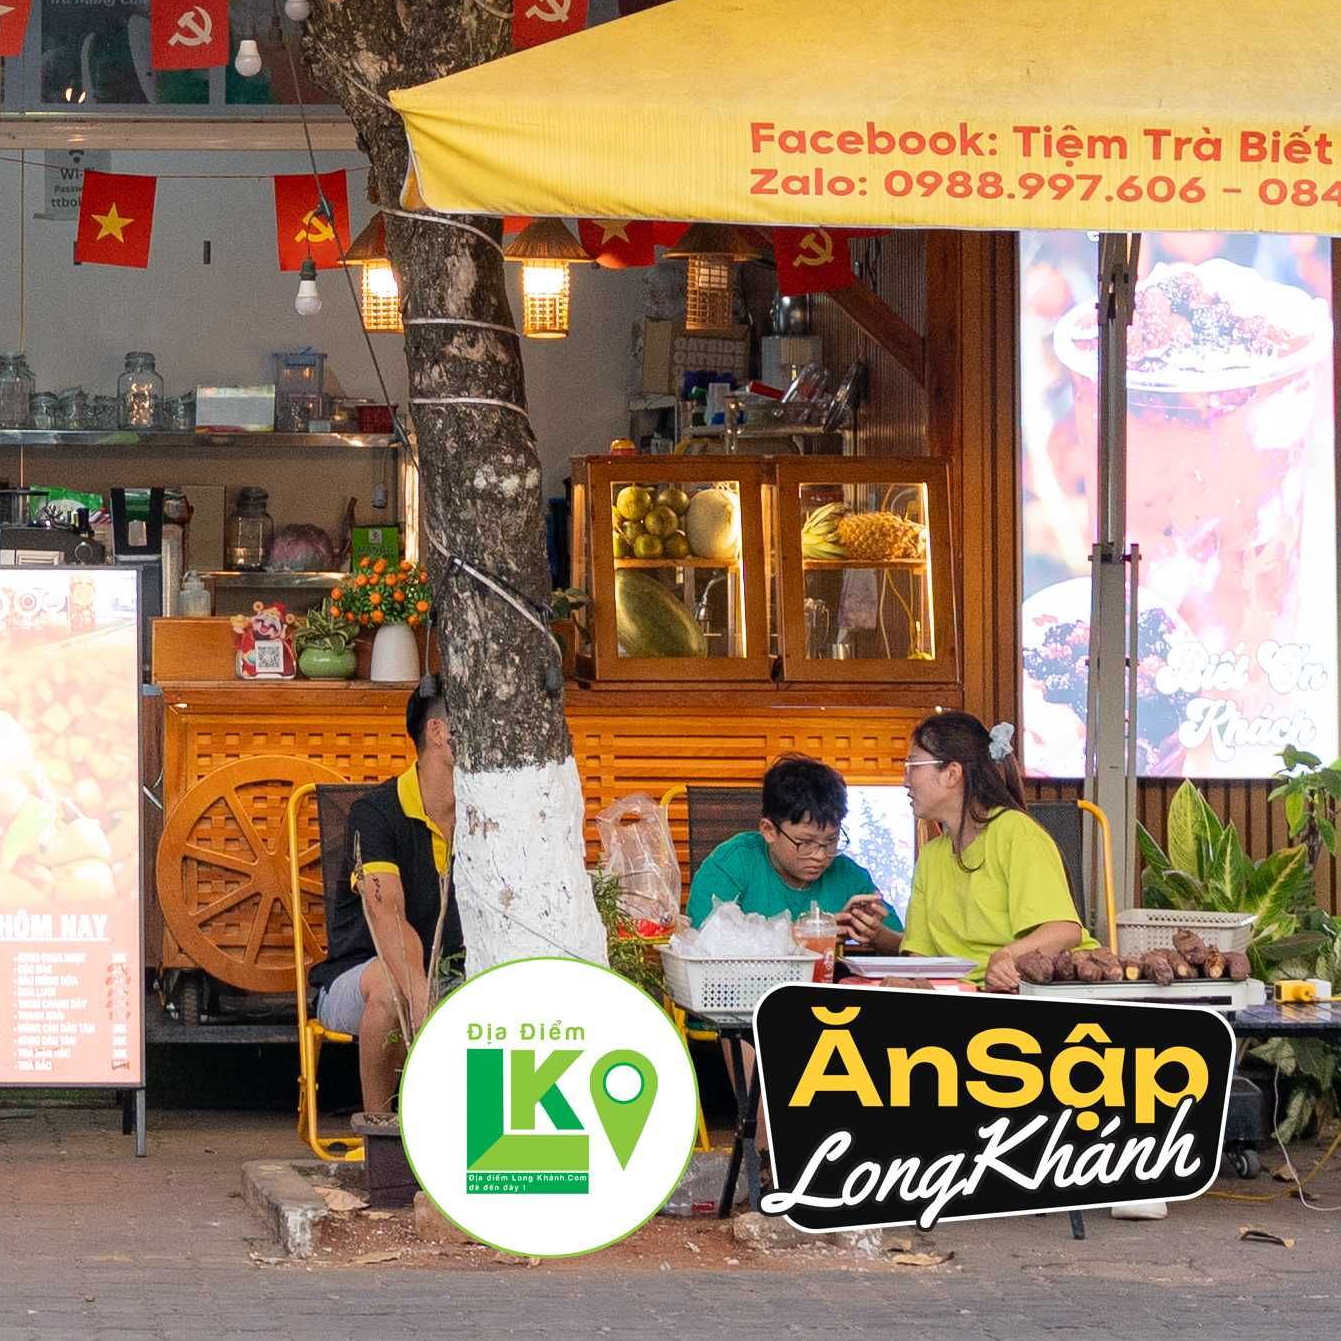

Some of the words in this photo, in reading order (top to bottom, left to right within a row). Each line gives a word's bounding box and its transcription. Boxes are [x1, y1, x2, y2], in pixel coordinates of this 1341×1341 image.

[750, 121, 997, 156] Facebook:
[1013, 124, 1127, 168] Tiệm
[1144, 126, 1222, 162] Trà
[1240, 125, 1333, 165] Biết
[750, 167, 868, 197] Zalo:
[884, 170, 1206, 203] 0988.997.606
[60, 913, 108, 939] NAY
